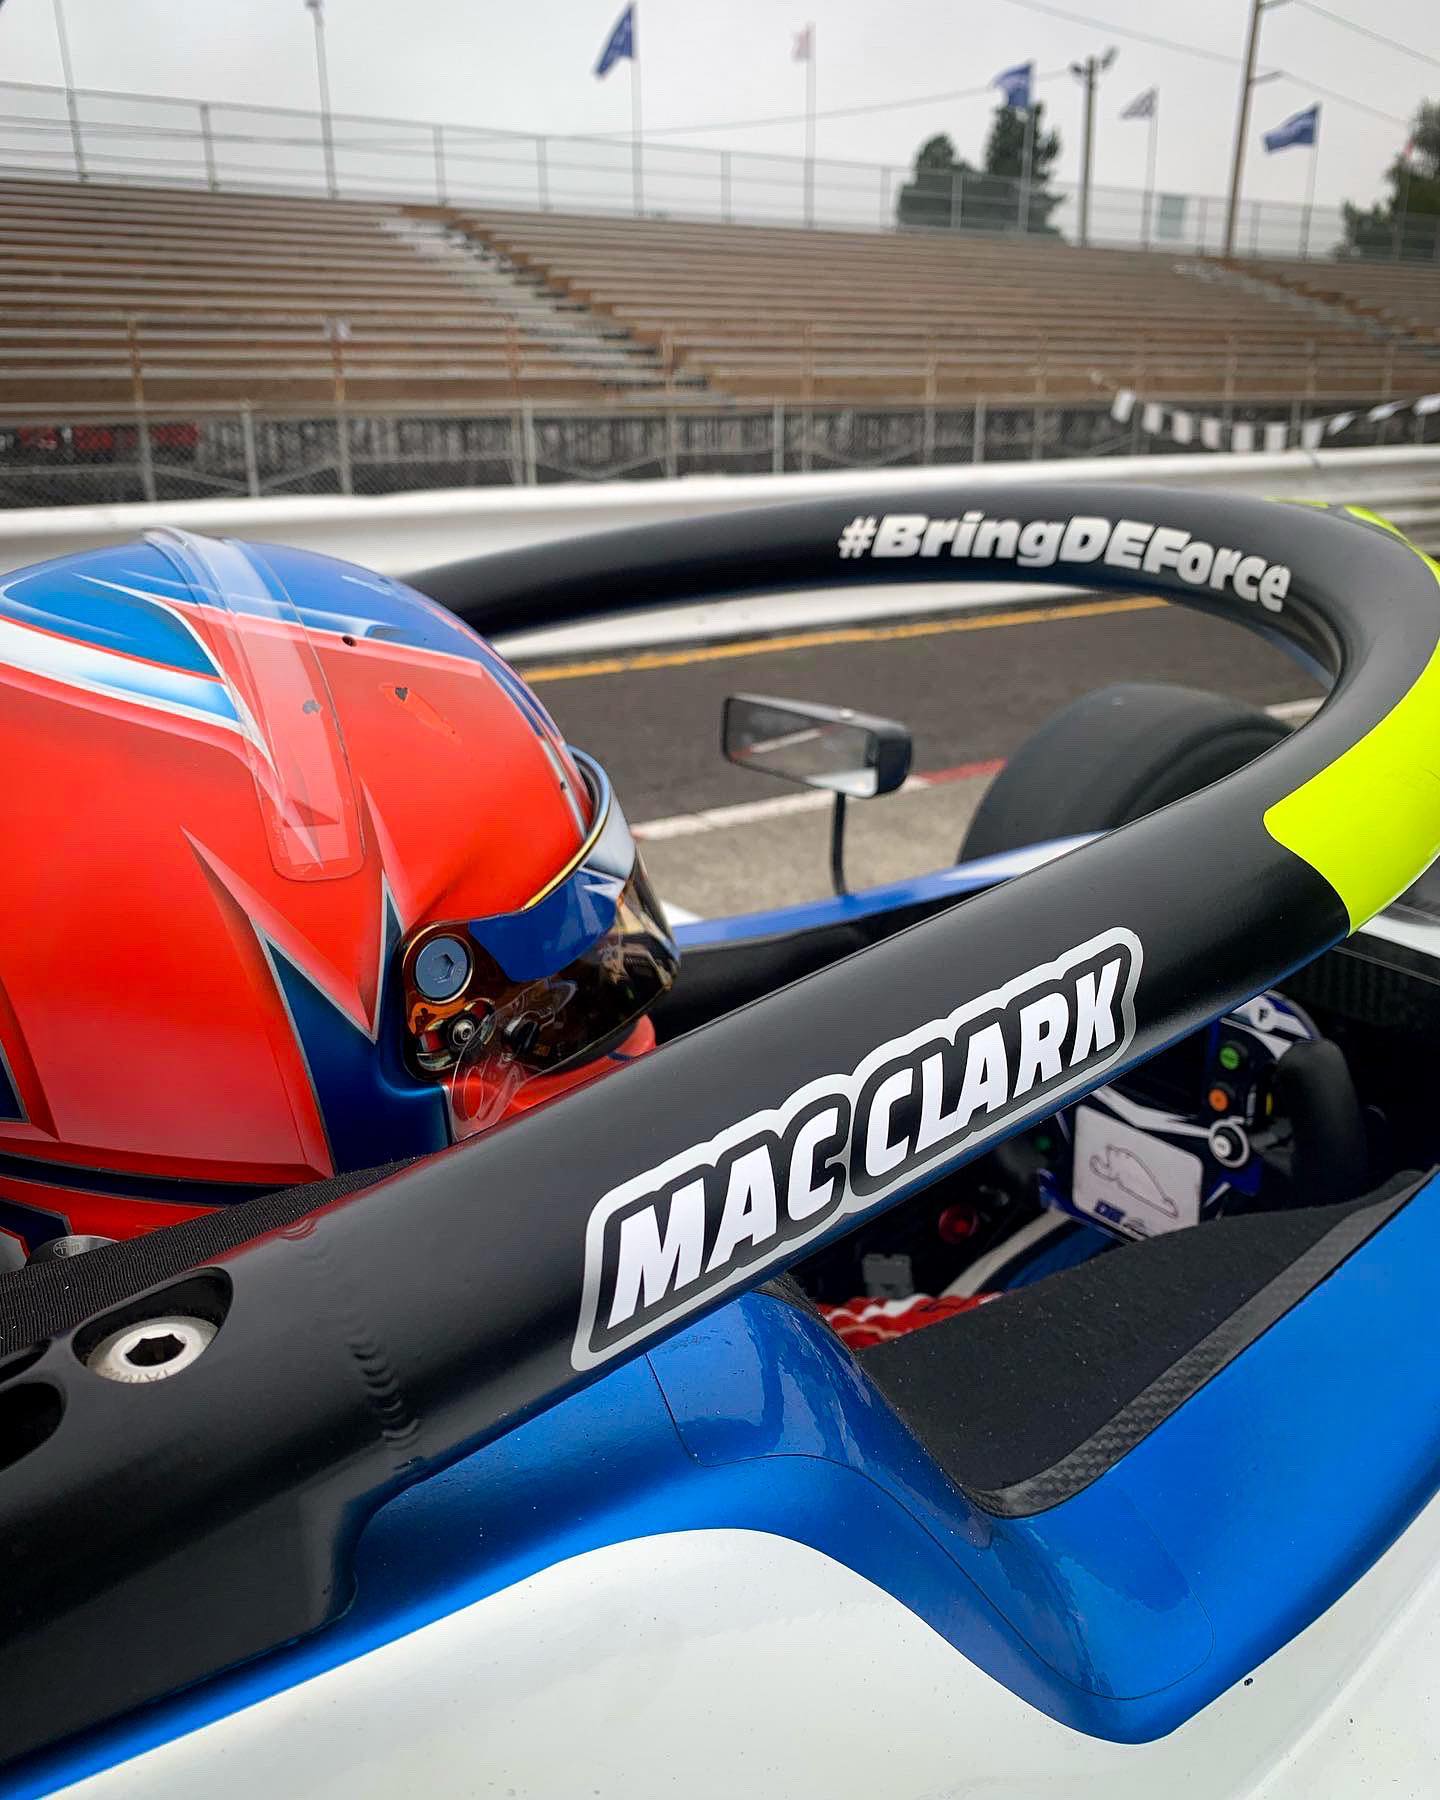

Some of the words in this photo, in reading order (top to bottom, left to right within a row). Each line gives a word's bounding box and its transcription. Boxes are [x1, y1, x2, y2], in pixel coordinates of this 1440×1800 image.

[838, 511, 1292, 612] #BringDEForce
[608, 1108, 839, 1329] MAC
[866, 958, 1122, 1177] CLARK
